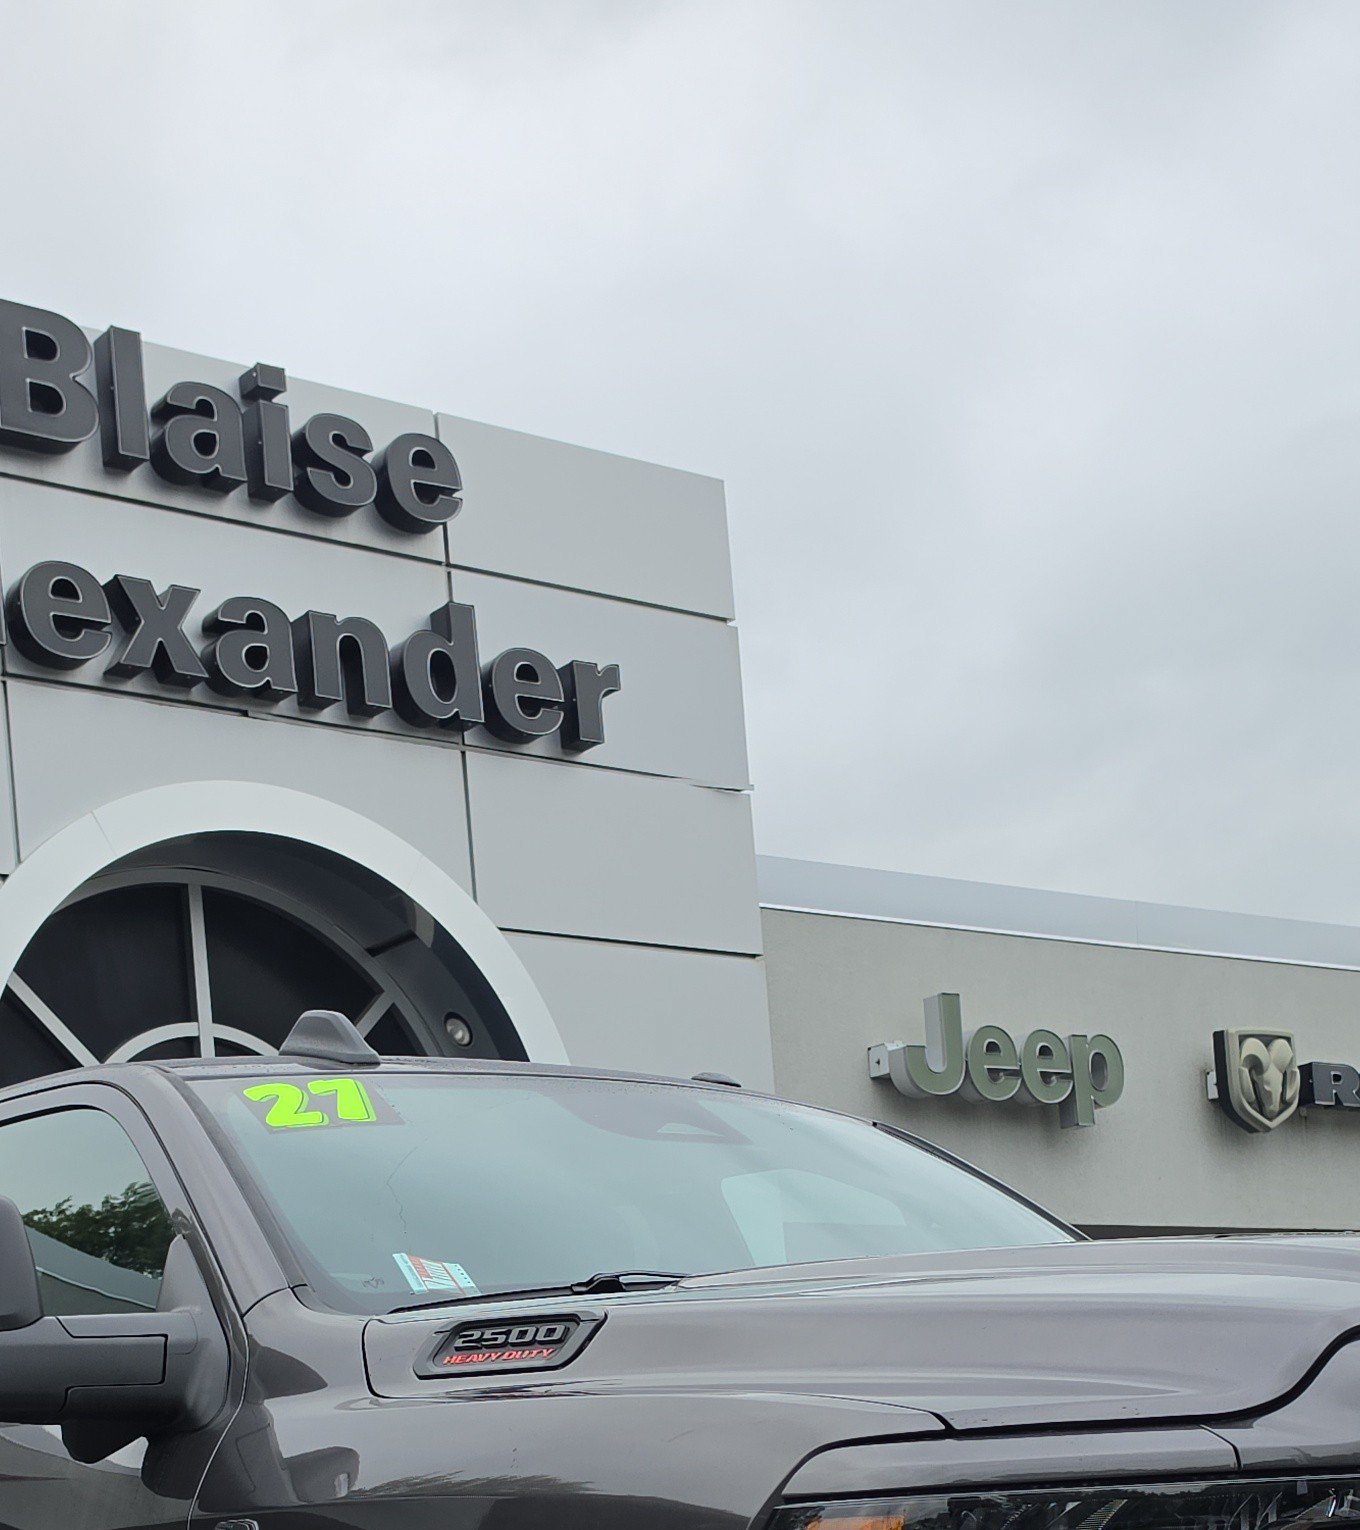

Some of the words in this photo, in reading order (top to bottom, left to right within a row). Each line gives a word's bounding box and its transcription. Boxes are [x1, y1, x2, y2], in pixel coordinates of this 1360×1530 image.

[889, 992, 1125, 1129] Jeep
[243, 1078, 377, 1128] 27
[443, 1350, 500, 1365] HEAVY
[501, 1348, 555, 1362] DUTY
[454, 1324, 569, 1351] 2500
